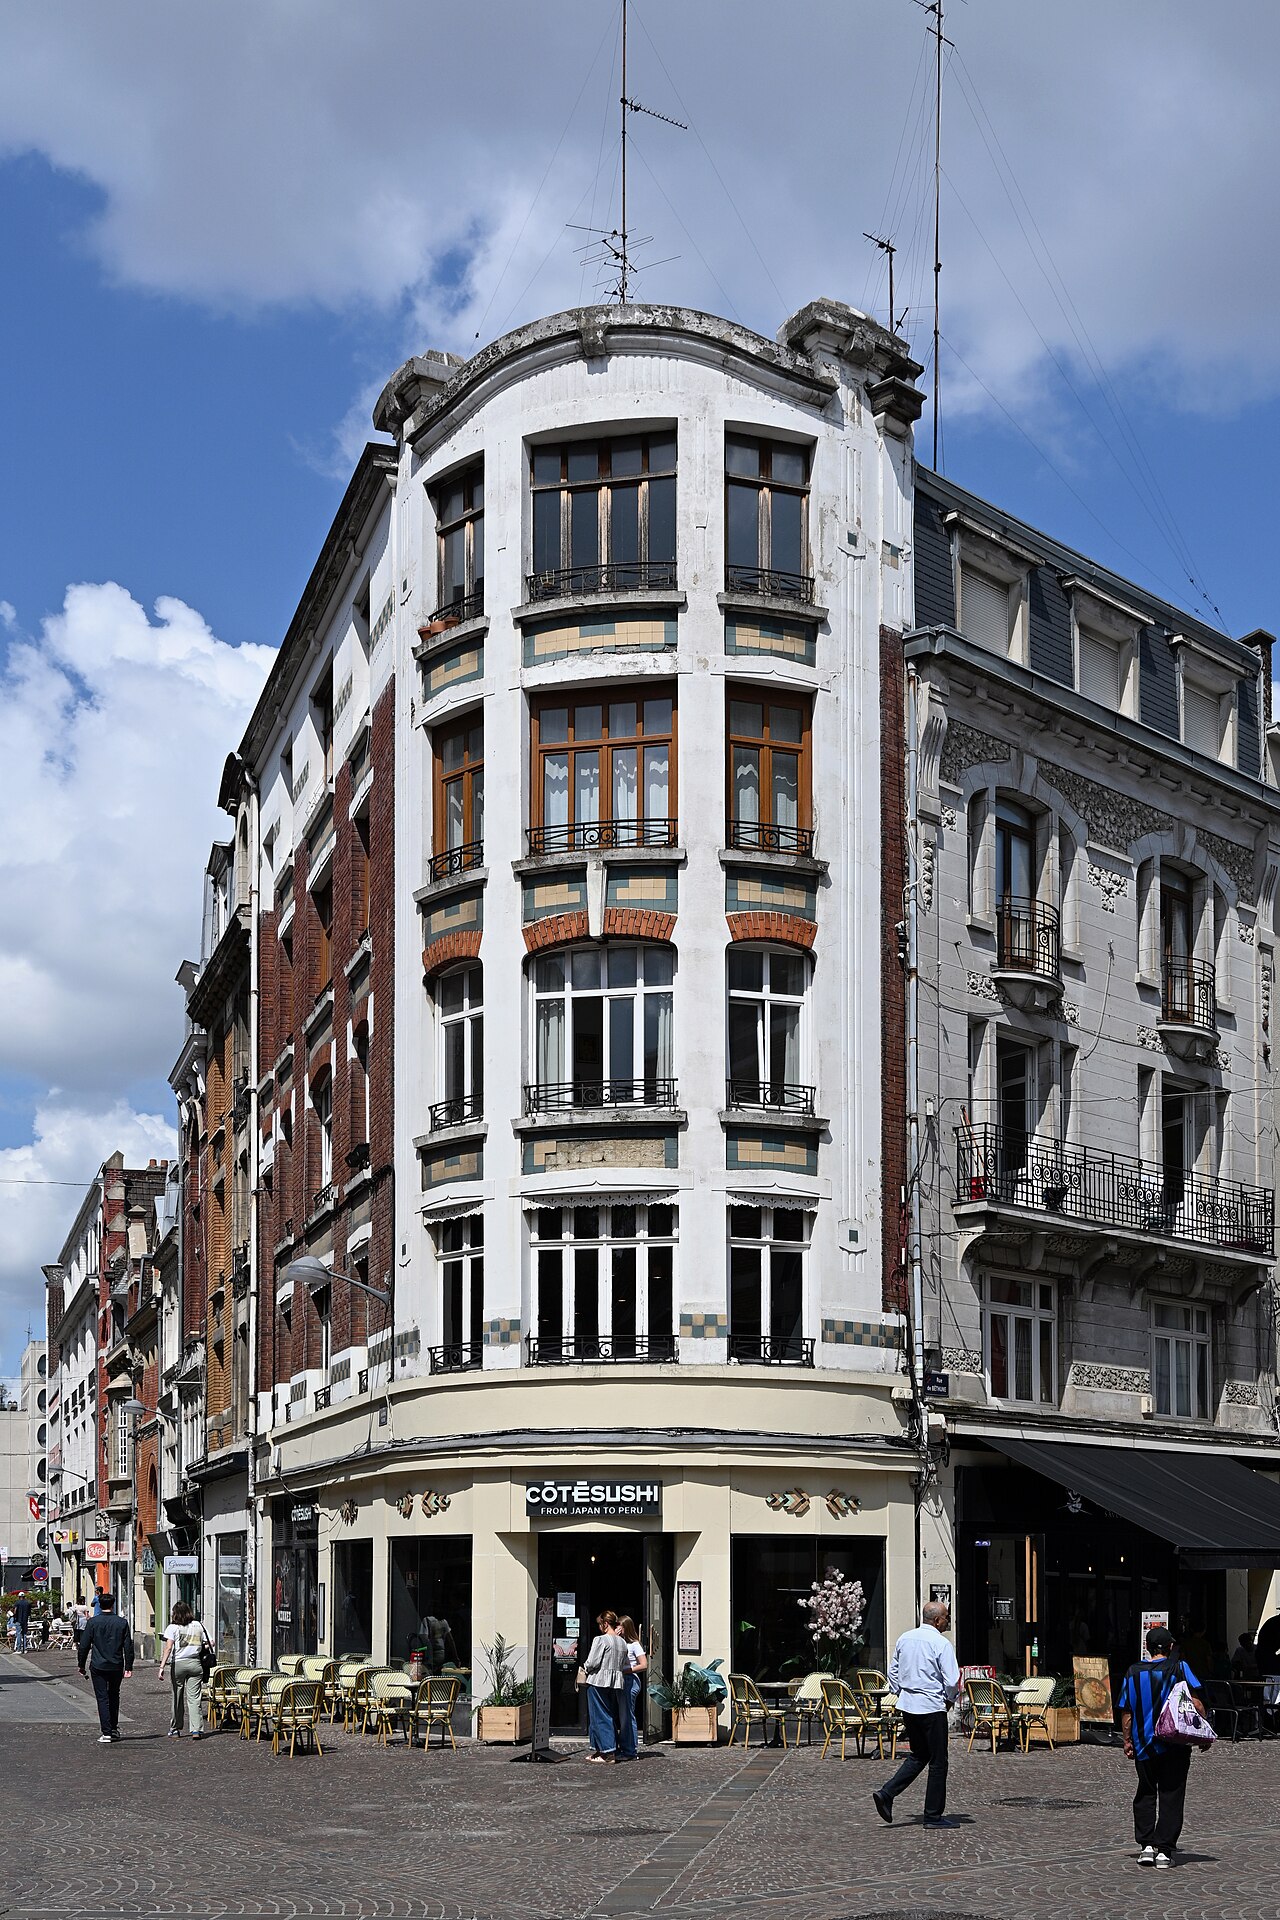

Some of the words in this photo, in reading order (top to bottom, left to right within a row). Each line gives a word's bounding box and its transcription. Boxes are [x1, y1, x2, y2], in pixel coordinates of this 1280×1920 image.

[540, 1507, 567, 1515] FROM
[570, 1507, 600, 1515] JAPAN
[603, 1506, 616, 1514] TO
[618, 1506, 643, 1514] PERU
